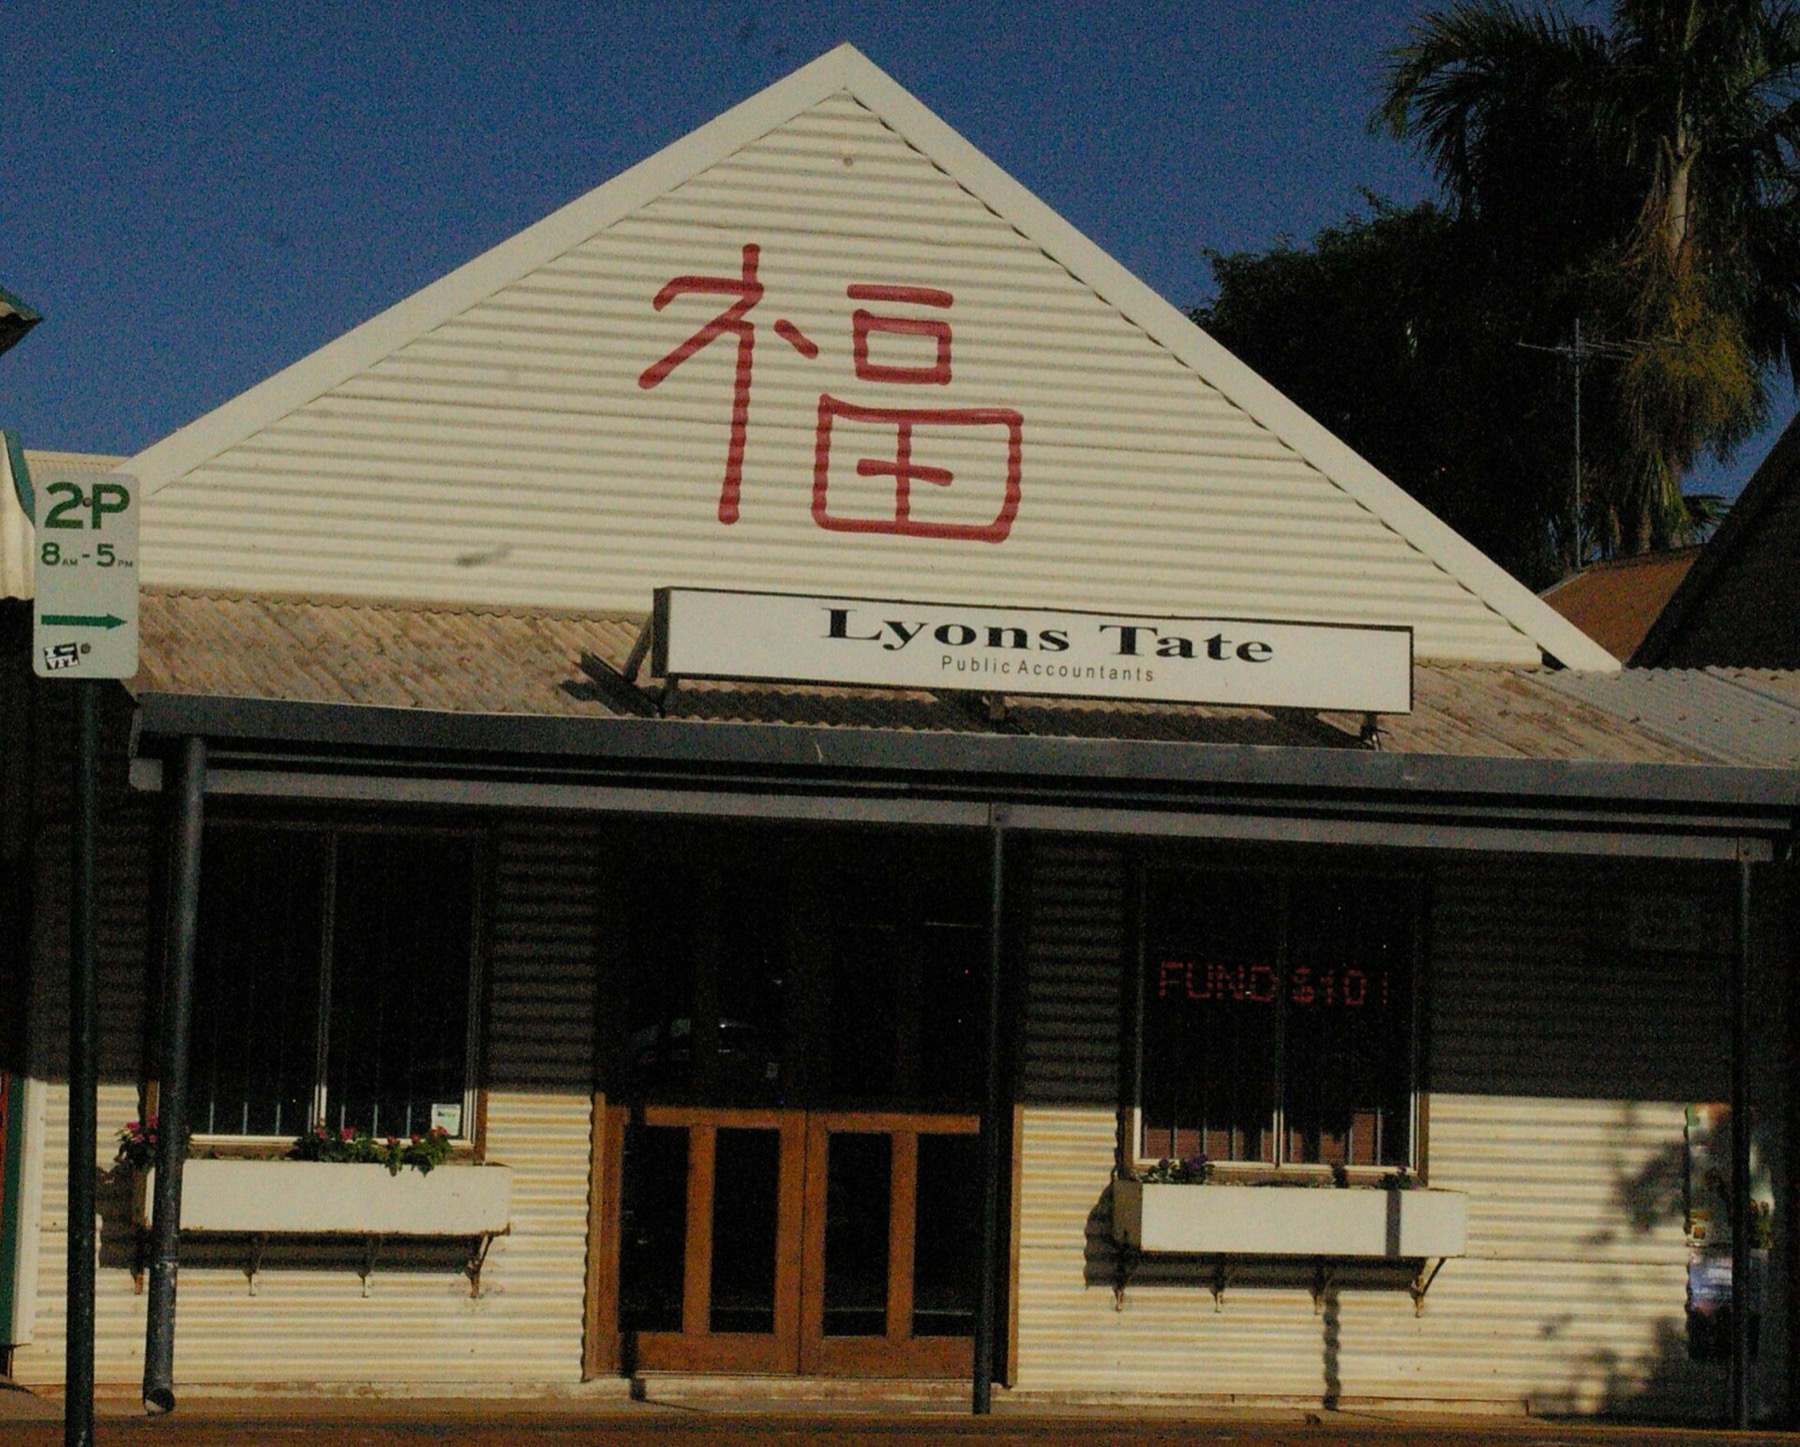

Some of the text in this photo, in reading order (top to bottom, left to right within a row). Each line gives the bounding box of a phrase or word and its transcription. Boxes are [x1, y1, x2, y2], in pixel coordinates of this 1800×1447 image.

[637, 243, 1025, 544] 福
[44, 481, 131, 530] 2P
[821, 608, 1274, 664] Lyons Tate
[941, 655, 1155, 682] Public Accountants
[1157, 960, 1280, 1002] FUND
